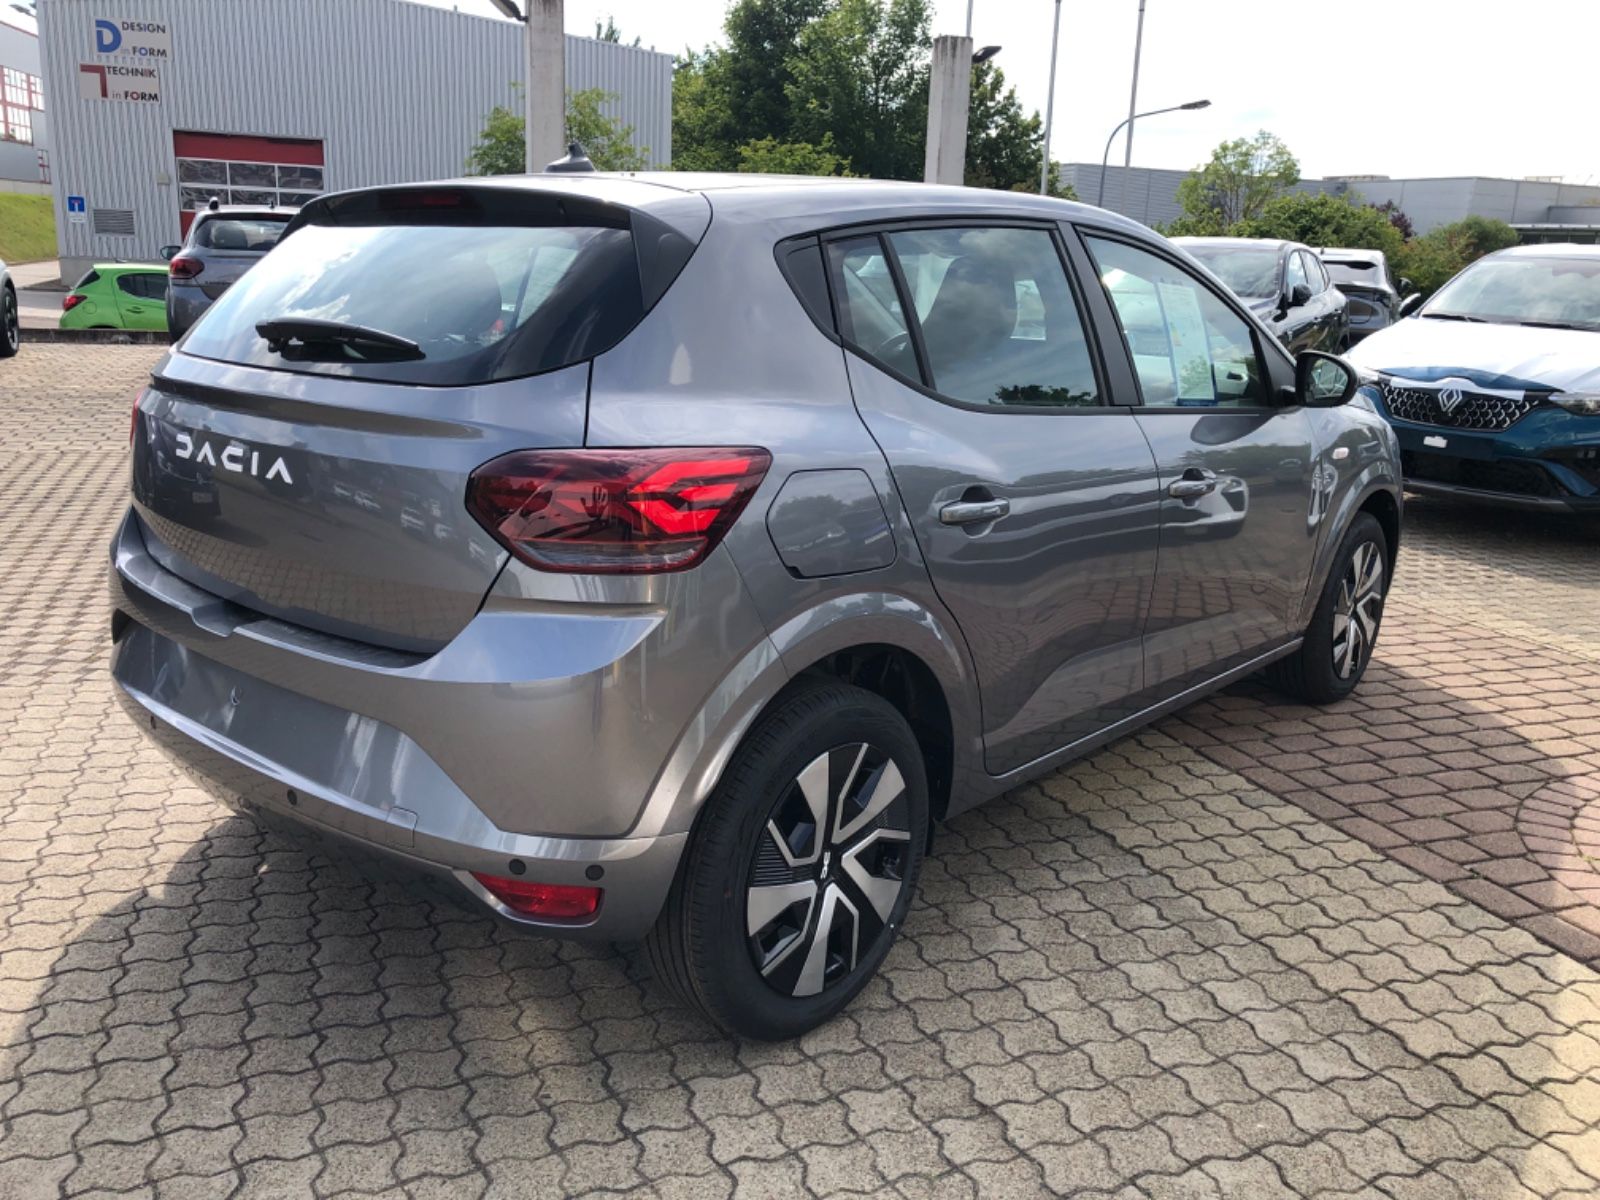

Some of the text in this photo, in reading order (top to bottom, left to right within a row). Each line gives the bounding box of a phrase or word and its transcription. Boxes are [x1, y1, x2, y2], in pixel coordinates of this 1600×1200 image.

[122, 21, 166, 33] DESIGN
[132, 46, 167, 57] FORM
[106, 66, 157, 78] TECHNIK
[124, 90, 159, 102] FORM
[175, 433, 293, 485] DACIA
